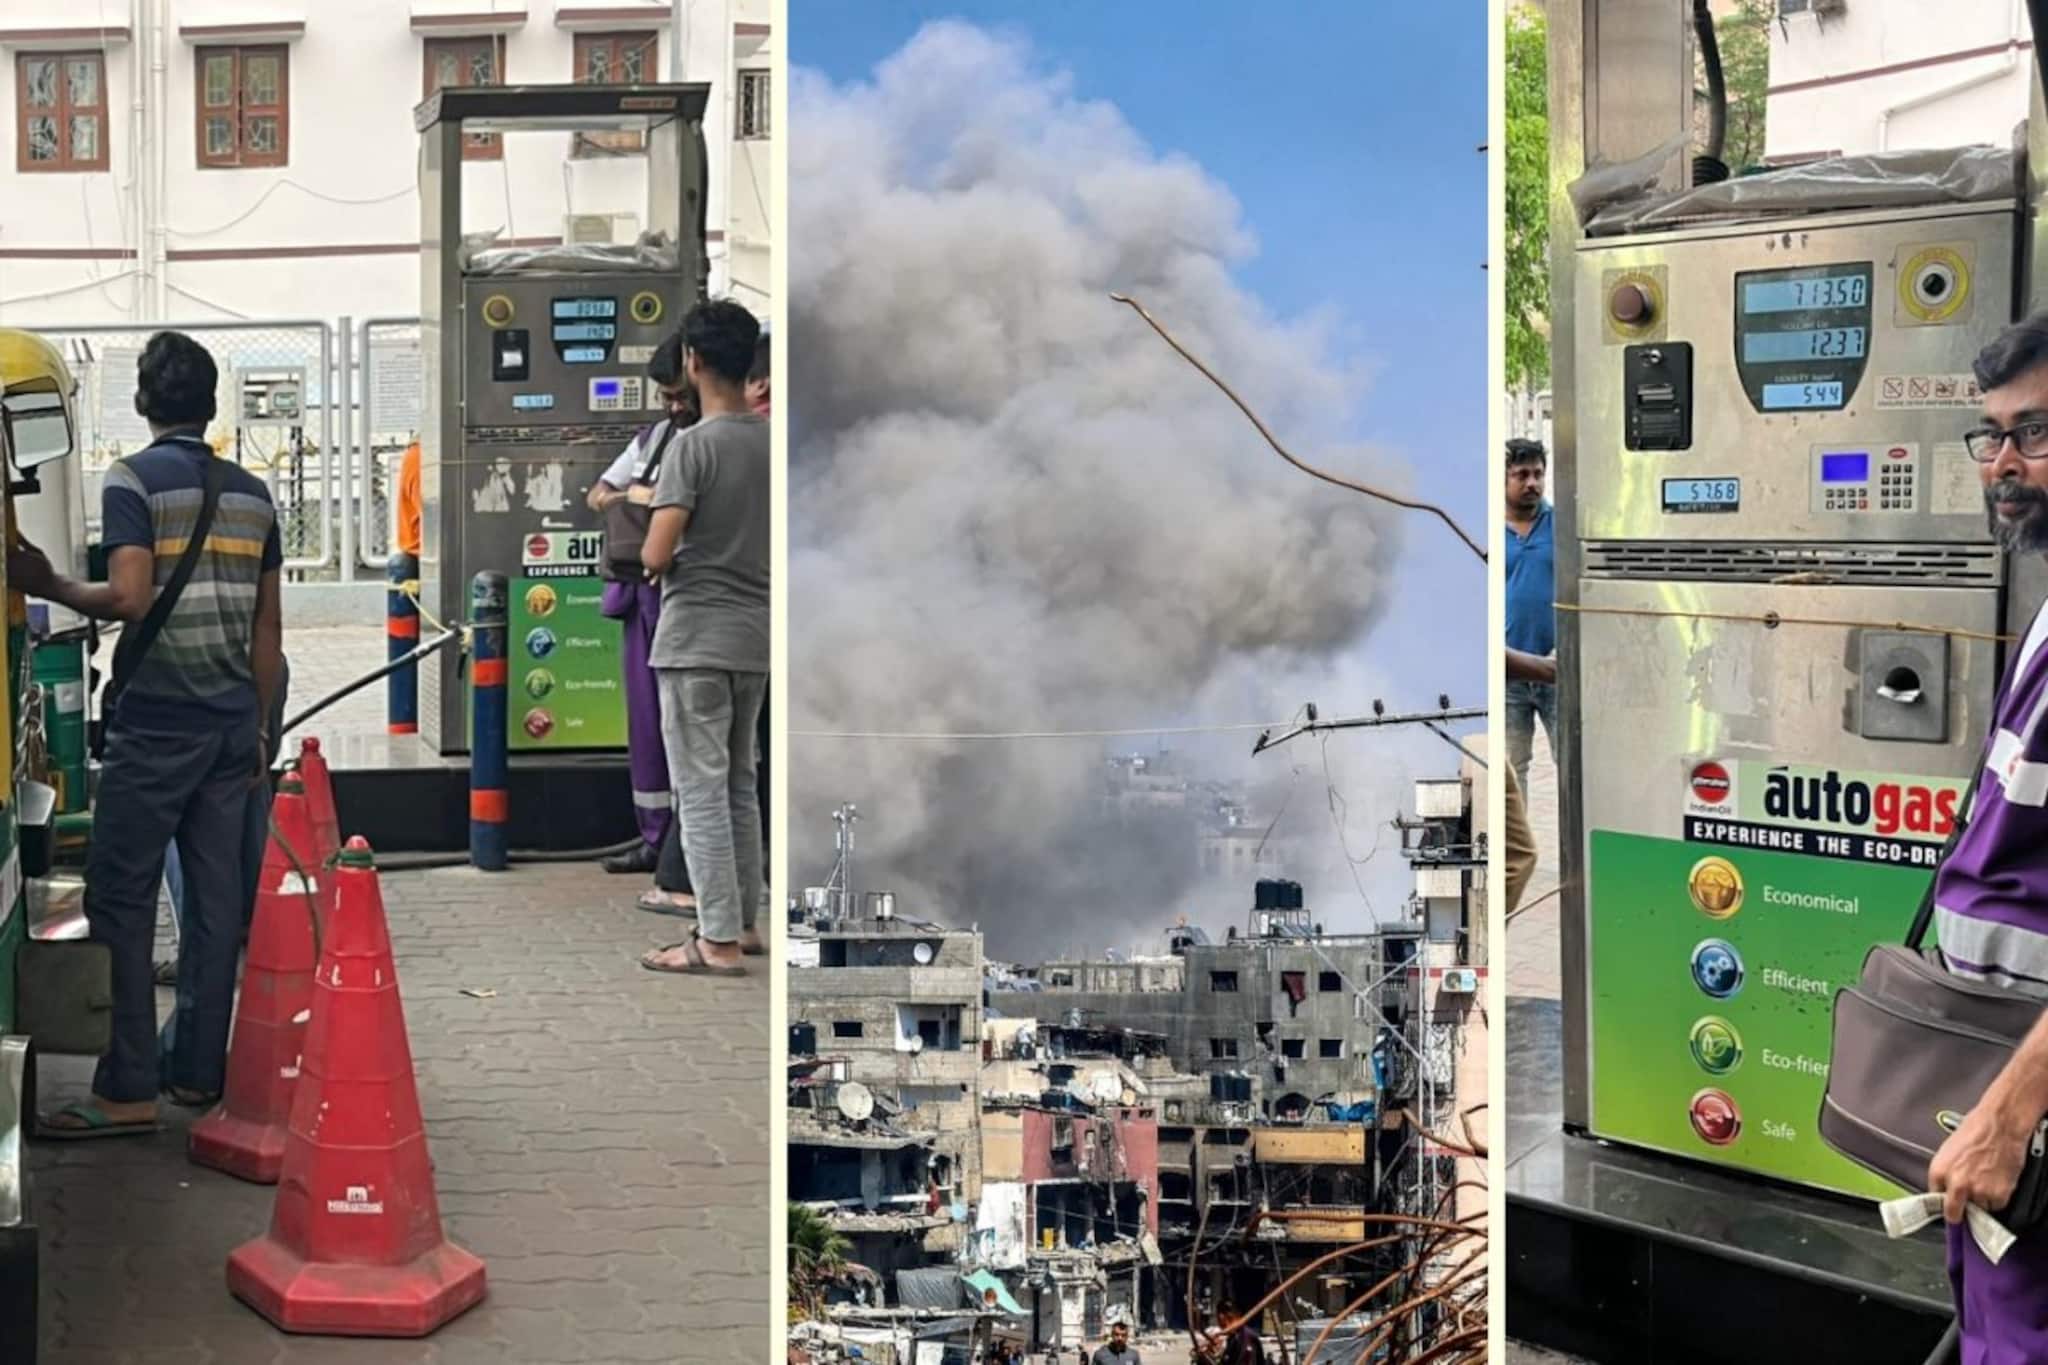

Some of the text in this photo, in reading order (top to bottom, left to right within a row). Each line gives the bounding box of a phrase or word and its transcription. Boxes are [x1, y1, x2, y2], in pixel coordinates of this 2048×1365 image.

[1795, 278, 1864, 306] 713.50
[1810, 329, 1862, 356] 12.37
[1803, 385, 1839, 404] 544
[527, 566, 589, 577] EXPERIENCE
[1693, 821, 1804, 850] EXPERIENCE
[1817, 835, 1850, 856] THE
[1763, 884, 1859, 915] Economical
[1762, 968, 1829, 996] Efficient
[1761, 1118, 1797, 1141] Safe
